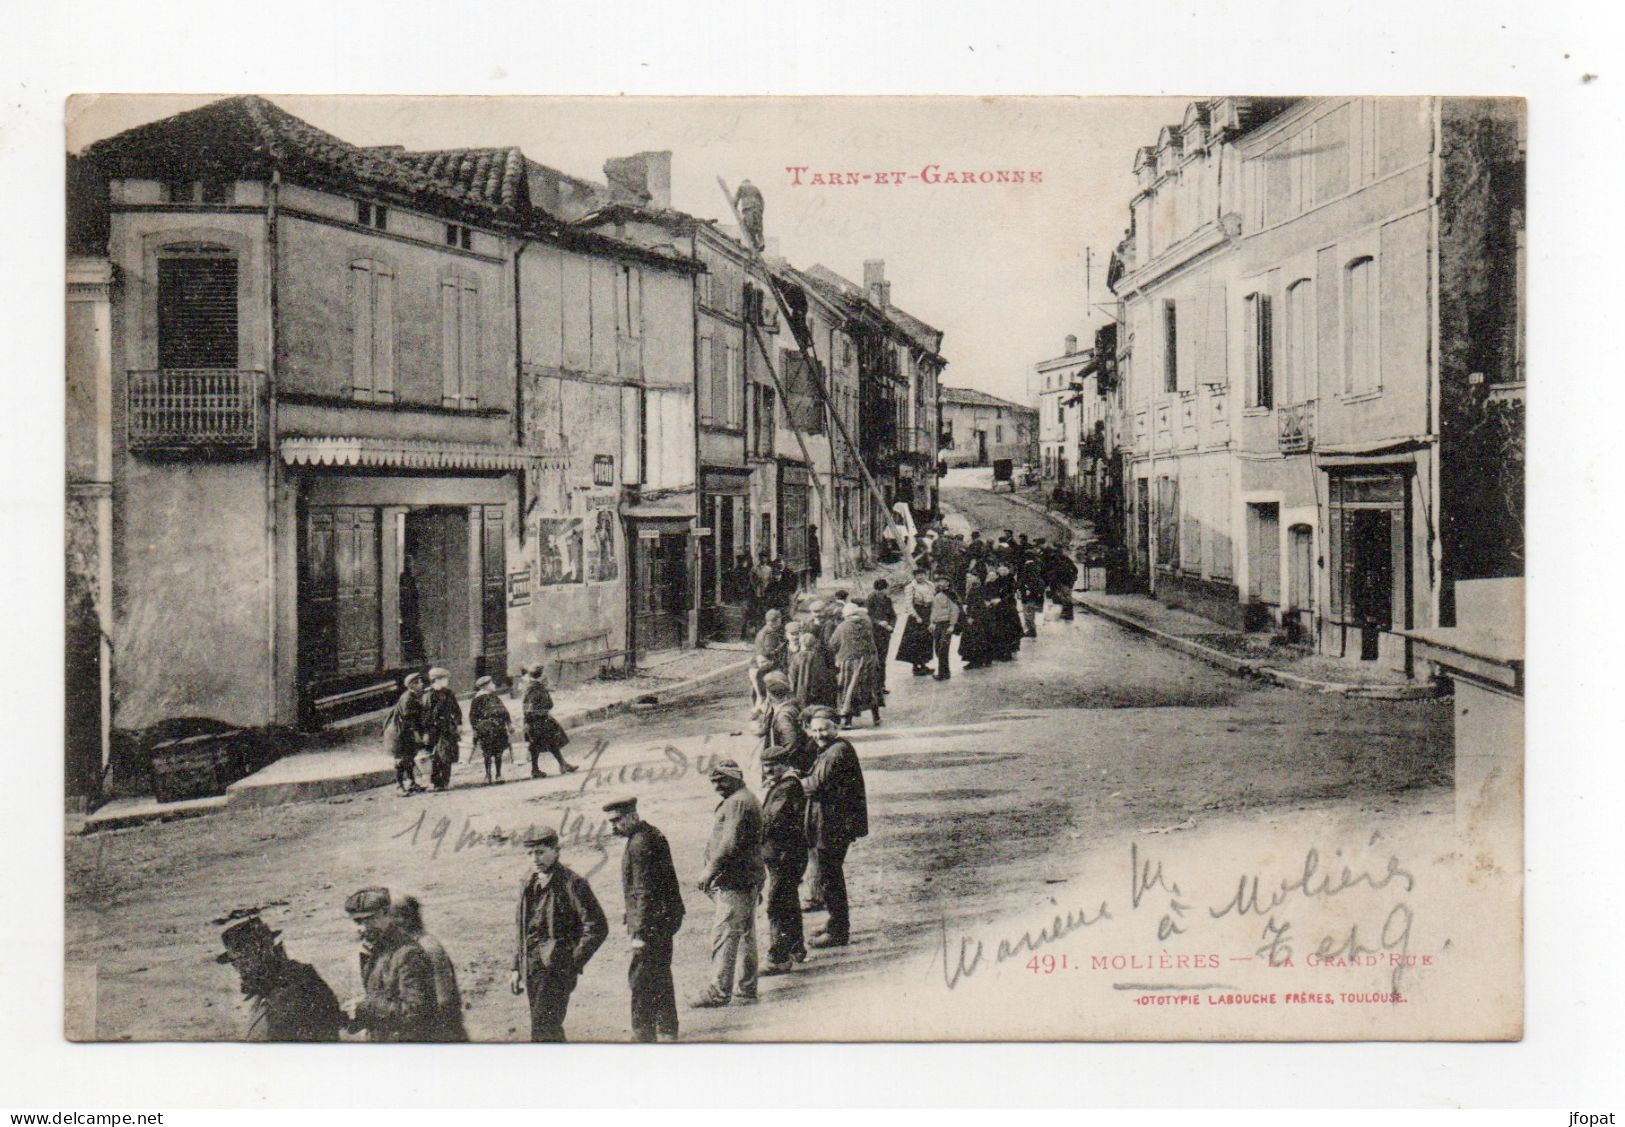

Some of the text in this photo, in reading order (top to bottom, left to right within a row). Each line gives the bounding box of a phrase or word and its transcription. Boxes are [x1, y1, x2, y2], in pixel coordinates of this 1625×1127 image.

[391, 809, 452, 860] 19
[1026, 954, 1080, 974] 491.
[1091, 949, 1221, 971] MOLIÈRES
[1208, 993, 1278, 1005] LABOUCHE
